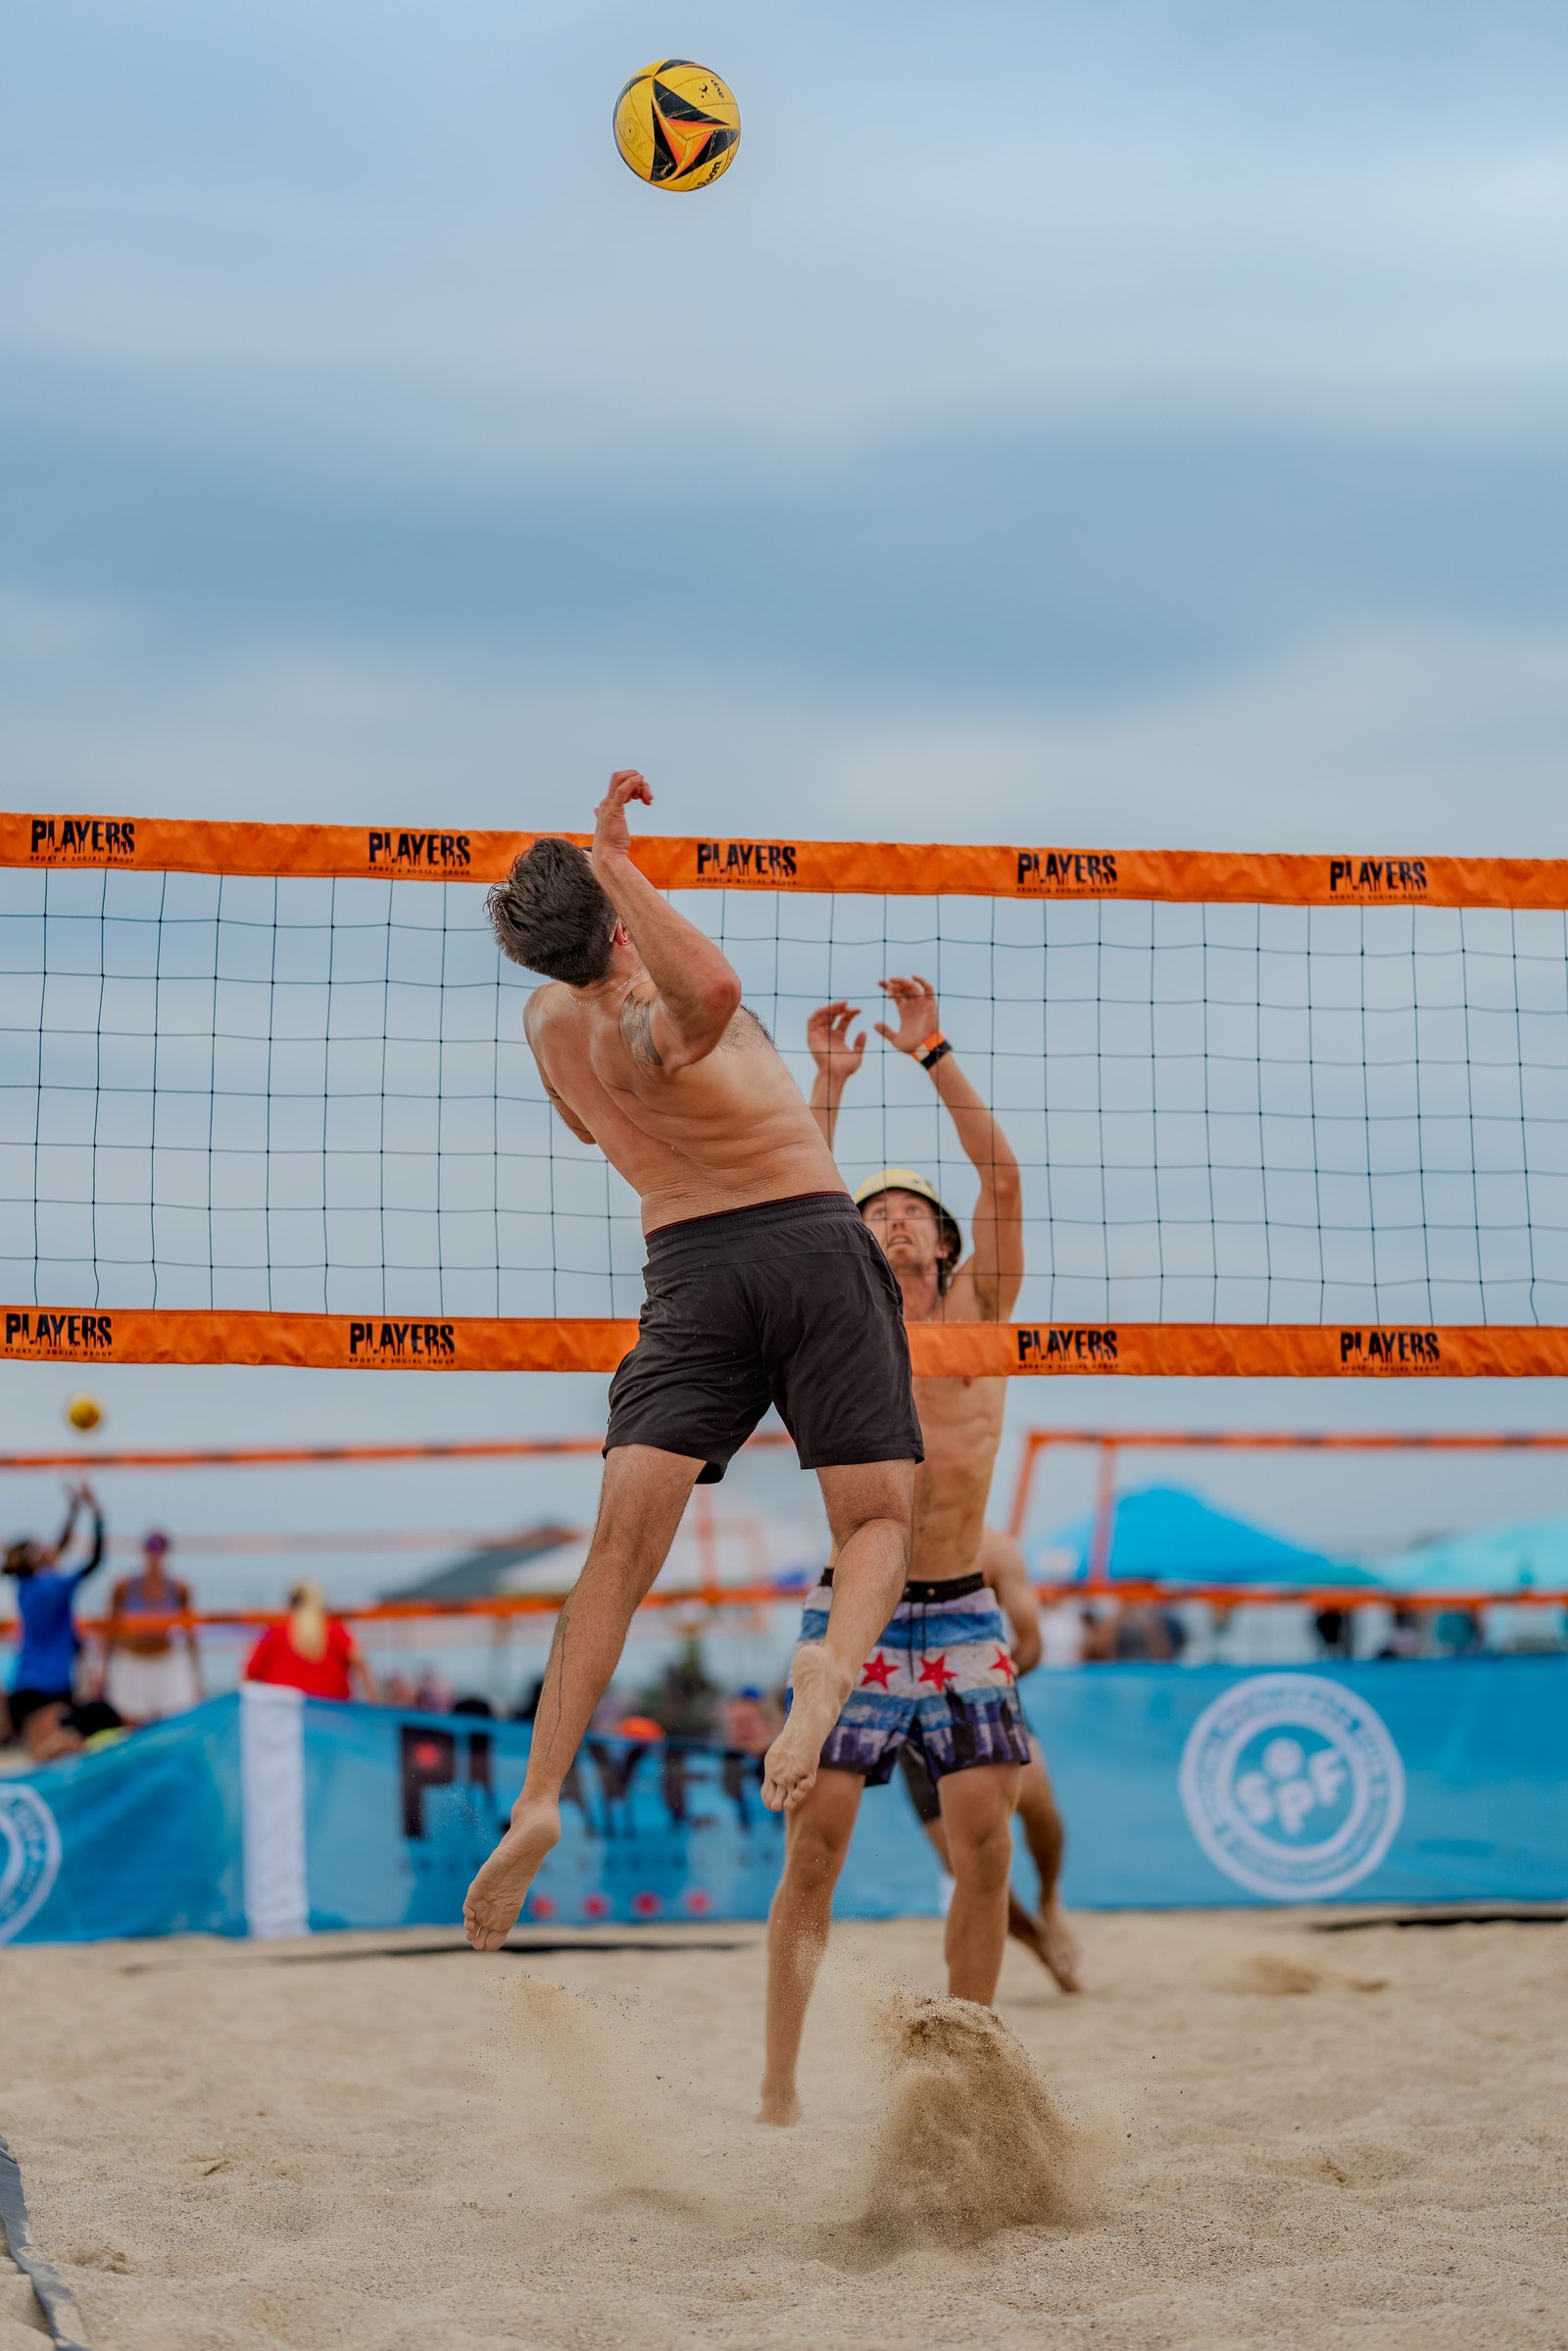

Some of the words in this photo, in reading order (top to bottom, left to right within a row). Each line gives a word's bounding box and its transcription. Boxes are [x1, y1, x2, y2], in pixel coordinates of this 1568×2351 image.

[31, 819, 135, 855] PLAYERS
[368, 831, 470, 867] PLAYERS
[697, 843, 797, 878] PLAYERS
[1017, 853, 1117, 886] PLAYERS
[1330, 860, 1427, 893] PLAYERS
[6, 1313, 113, 1349] PLAYERS
[350, 1322, 455, 1357] PLAYERS
[1017, 1330, 1118, 1361] PLAYERS
[1340, 1331, 1441, 1364] PLAYERS
